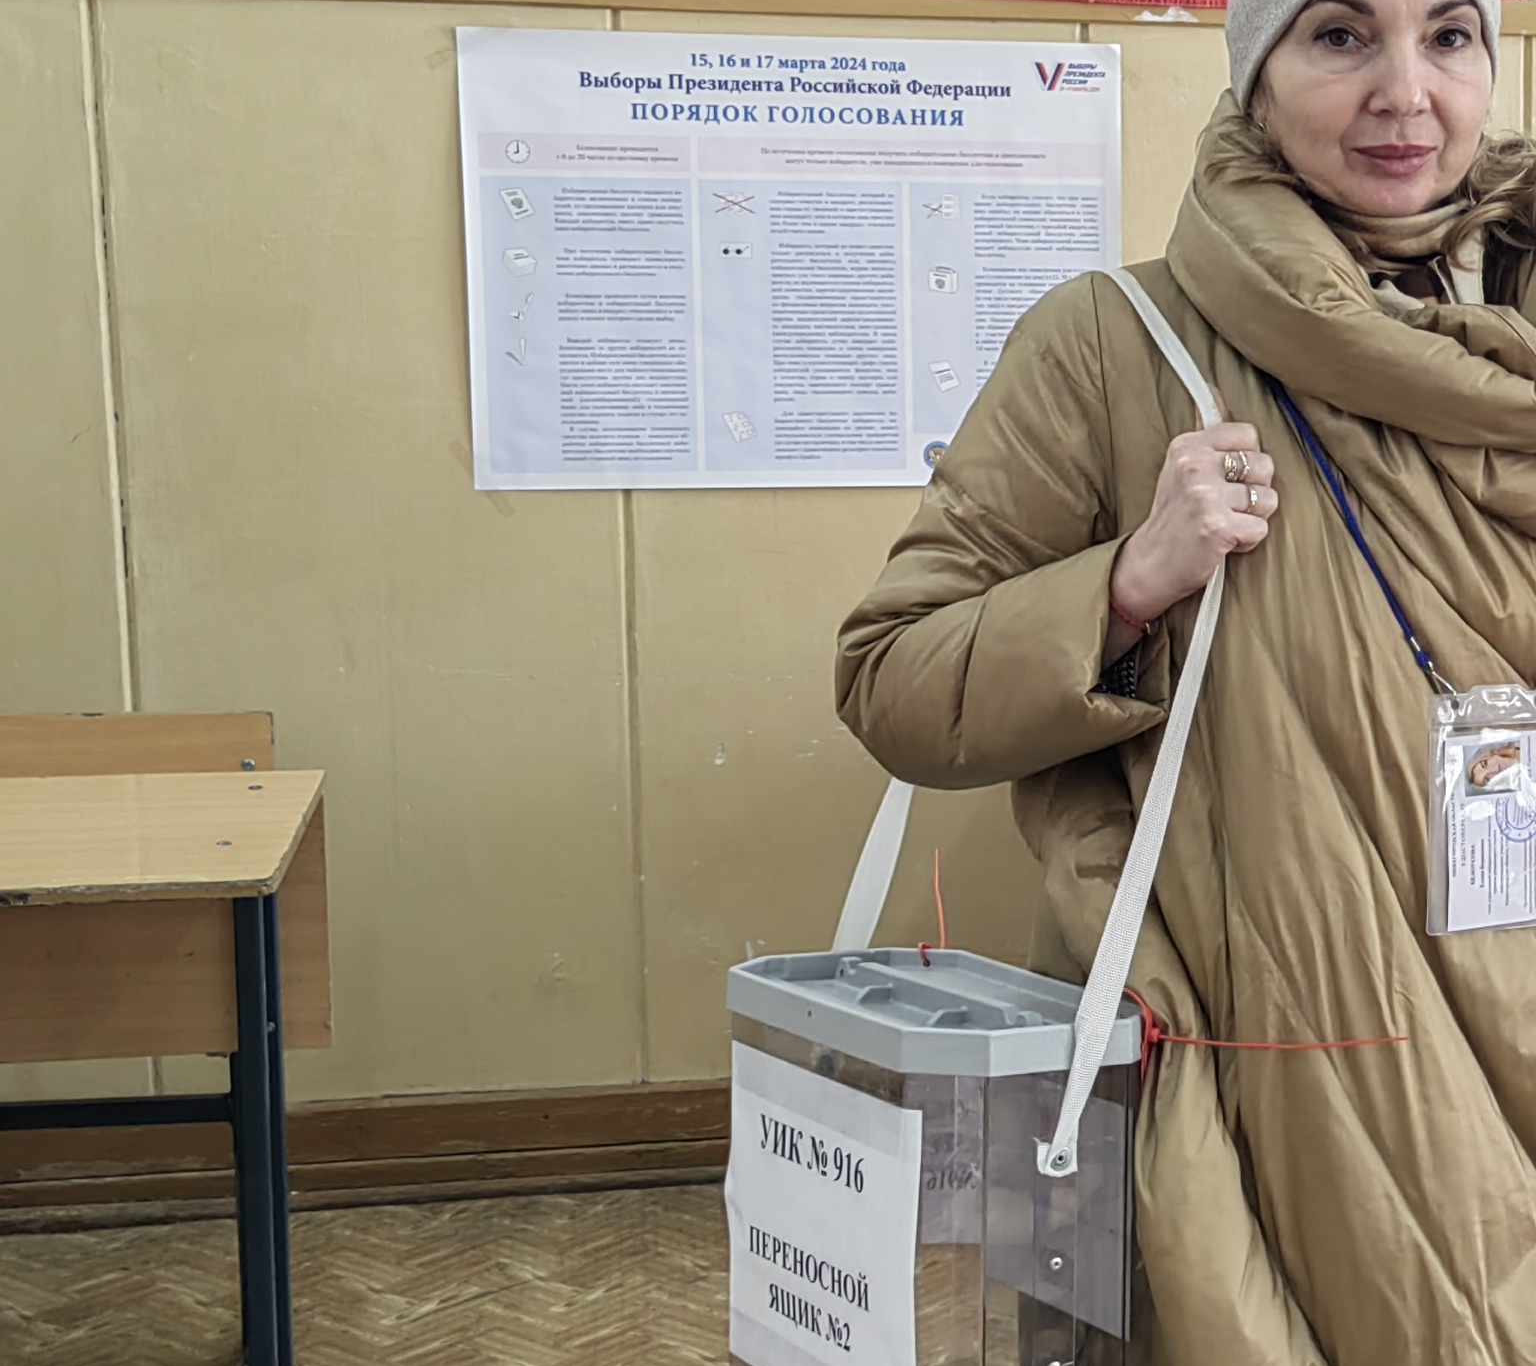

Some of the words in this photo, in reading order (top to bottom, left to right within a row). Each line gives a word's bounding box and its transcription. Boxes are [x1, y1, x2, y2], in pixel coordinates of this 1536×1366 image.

[579, 71, 662, 93] Выборы
[668, 73, 785, 95] Президента
[789, 76, 901, 95] Российской
[906, 79, 1012, 101] Федерации
[690, 52, 714, 69] 15,
[718, 53, 737, 68] 16
[740, 57, 751, 68] и
[756, 55, 774, 69] 17
[777, 57, 827, 73] марта
[830, 56, 868, 71] 2024
[871, 59, 906, 74] года
[630, 102, 759, 125] ПОРЯДОК
[767, 105, 965, 127] ГОЛОСОВАНИЯ
[760, 1113, 803, 1165] УИК
[807, 1135, 828, 1176] №
[833, 1146, 865, 1194] 916
[749, 1224, 870, 1312] ПЕРЕНОСНОЙ
[769, 1283, 822, 1337] ЯЩИК
[825, 1313, 851, 1353] №2
